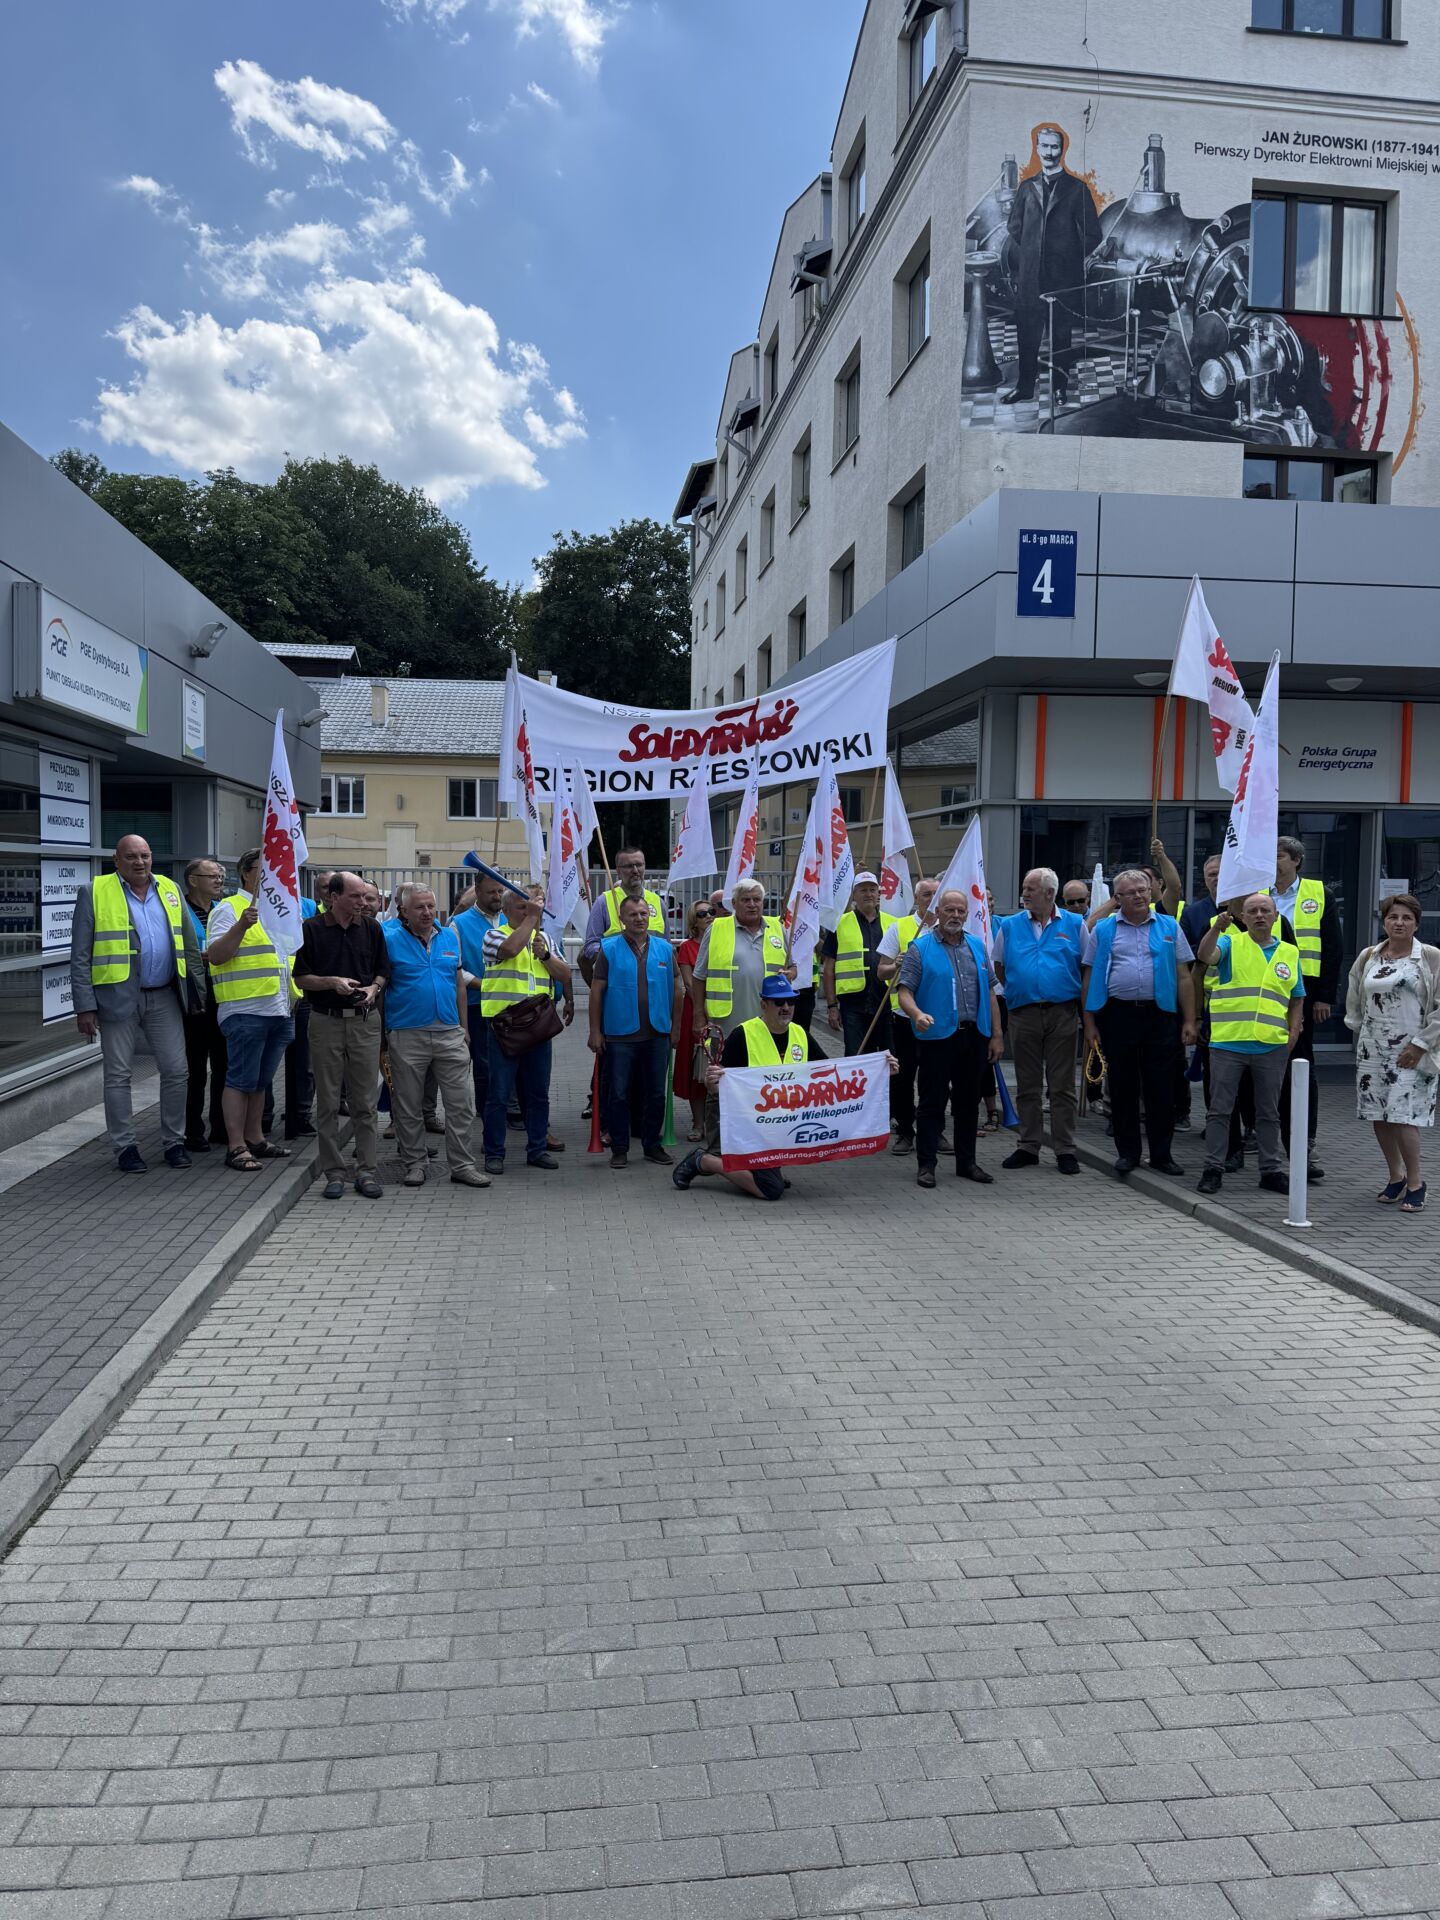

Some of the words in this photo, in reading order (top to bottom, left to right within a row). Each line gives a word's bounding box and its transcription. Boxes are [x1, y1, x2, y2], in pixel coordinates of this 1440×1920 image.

[1262, 130, 1289, 144] JAN
[1293, 131, 1368, 151] ŻUROWSKI
[1194, 142, 1249, 160] Pierwszy
[1254, 147, 1305, 164] Dyrektor
[1309, 152, 1372, 169] Elektrowni
[1376, 157, 1428, 175] Miejskiej
[1022, 534, 1031, 543] ul.
[1033, 534, 1047, 545] 8-go
[1050, 534, 1074, 544] MARCA
[1032, 558, 1054, 603] 4
[50, 634, 68, 657] PGE
[80, 641, 91, 658] PGE
[92, 648, 120, 675] Dystrybucja
[121, 663, 130, 677] S.A.
[46, 667, 61, 683] PUNKT
[603, 705, 650, 718] NSZZ
[1302, 746, 1337, 756] Polska
[1342, 747, 1377, 759] Grupa
[1298, 758, 1374, 771] Energetyczna
[763, 1072, 795, 1083] NSZZ
[756, 1115, 798, 1124] Gorzów
[801, 1102, 863, 1121] Wielkopolski
[794, 1129, 839, 1144] Enea
